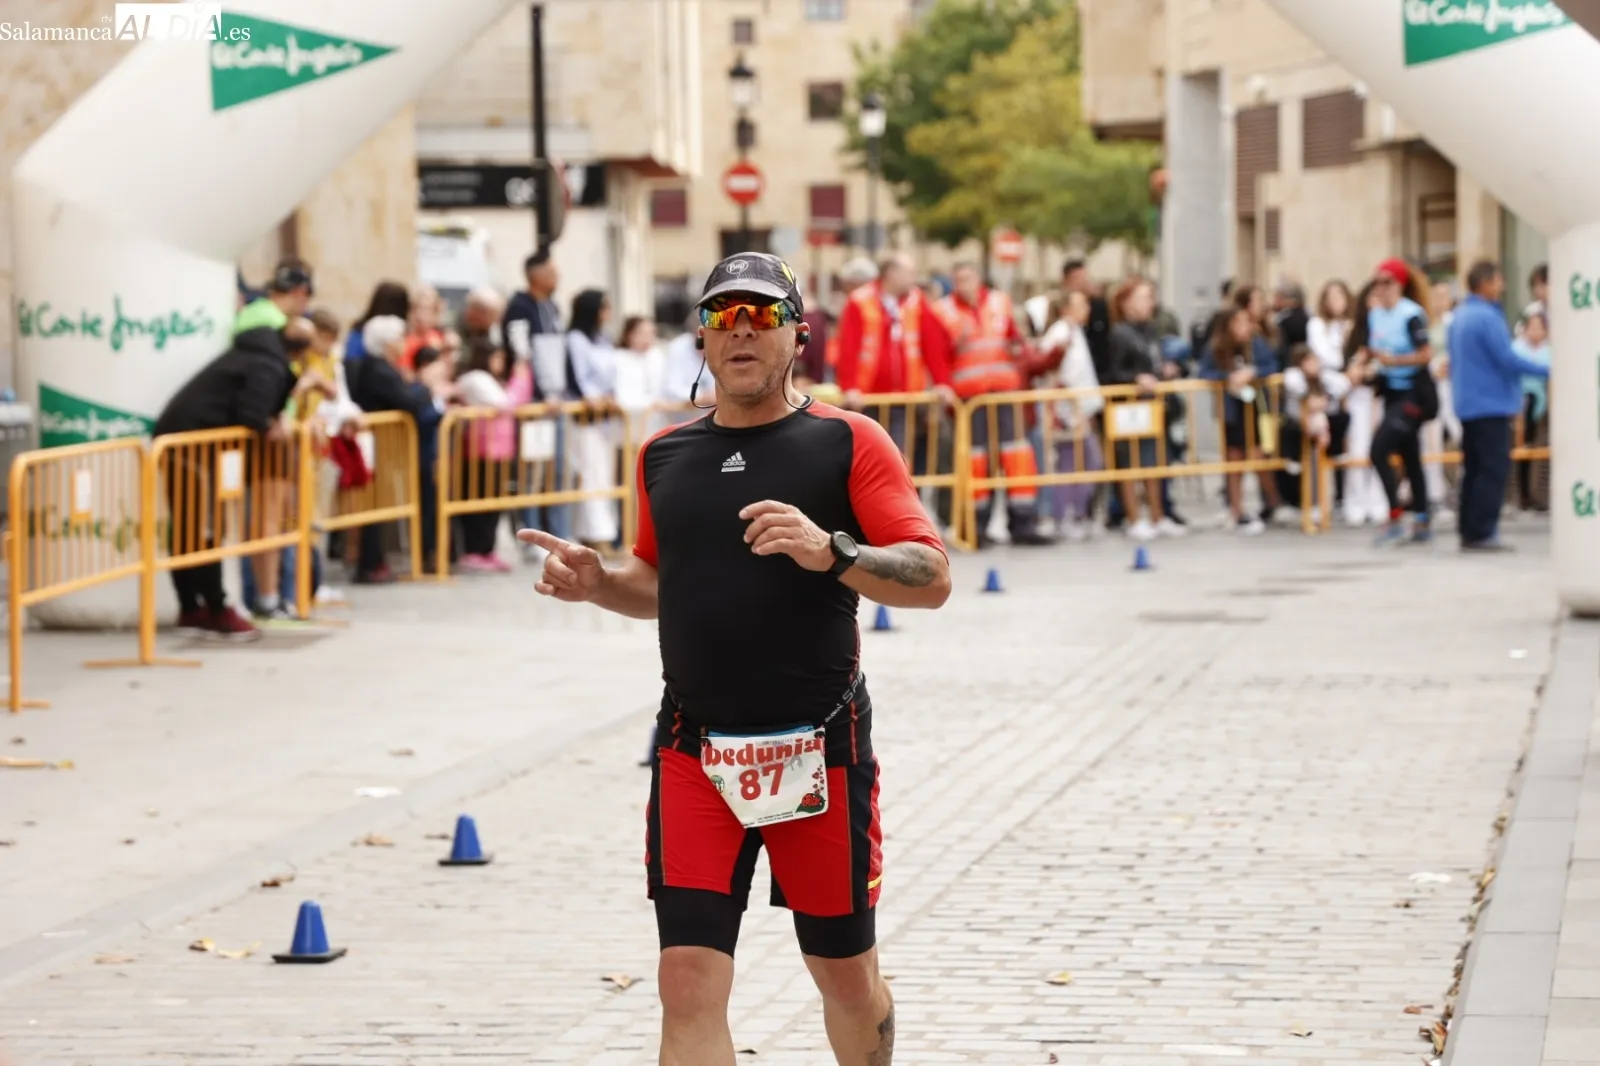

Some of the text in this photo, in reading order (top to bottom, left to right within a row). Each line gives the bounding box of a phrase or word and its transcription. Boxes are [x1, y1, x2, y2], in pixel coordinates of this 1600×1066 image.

[36, 302, 102, 338] Corte
[704, 738, 822, 767] bedunia
[739, 763, 784, 801] 87
